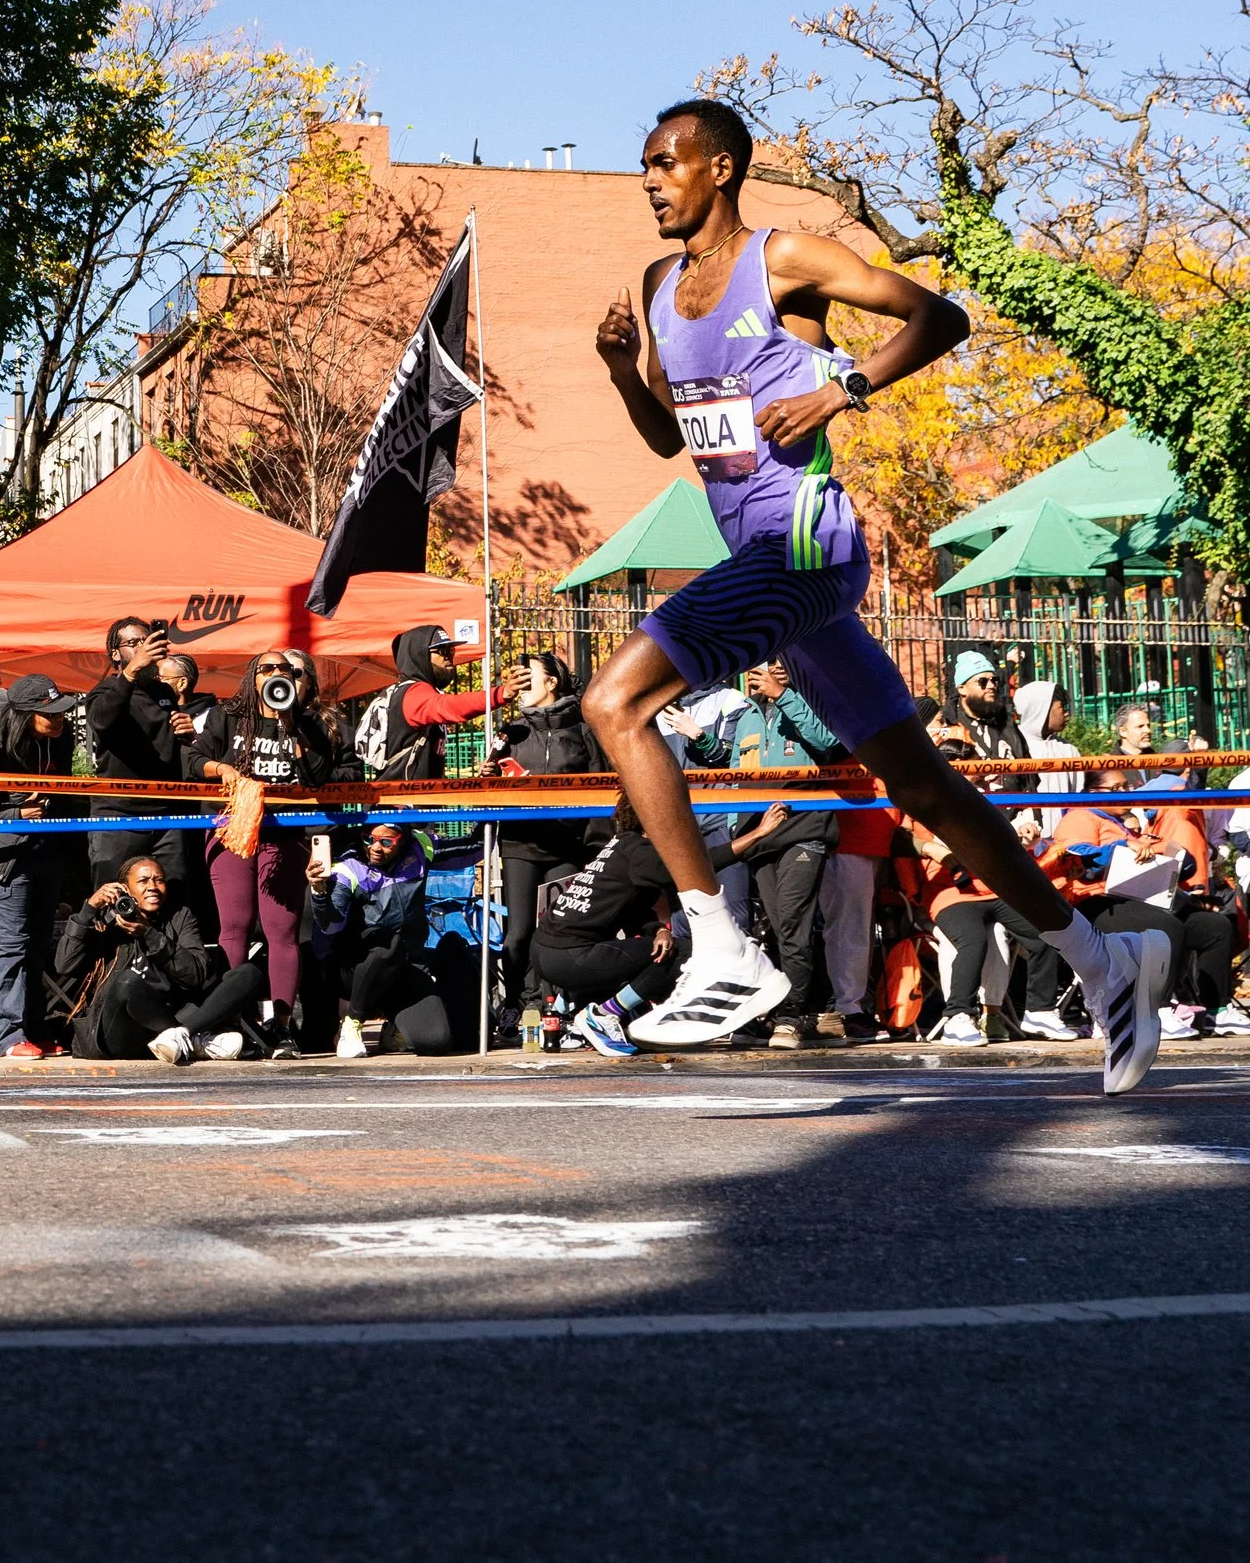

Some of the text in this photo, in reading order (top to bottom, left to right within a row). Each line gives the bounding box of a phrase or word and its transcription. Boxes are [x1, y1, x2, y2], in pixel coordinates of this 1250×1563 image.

[682, 414, 736, 450] TOLA
[183, 595, 245, 621] RUN
[974, 763, 1012, 774] YORK
[1061, 760, 1095, 771] NEW
[1098, 759, 1136, 769] YORK
[1183, 756, 1216, 767] NEW
[398, 782, 436, 790] NEW
[441, 780, 484, 789] YORK
[537, 777, 575, 787] NEW
[578, 776, 620, 786] YORK
[685, 772, 709, 782] EW
[714, 771, 756, 781] YORK
[807, 769, 842, 778] NEW
